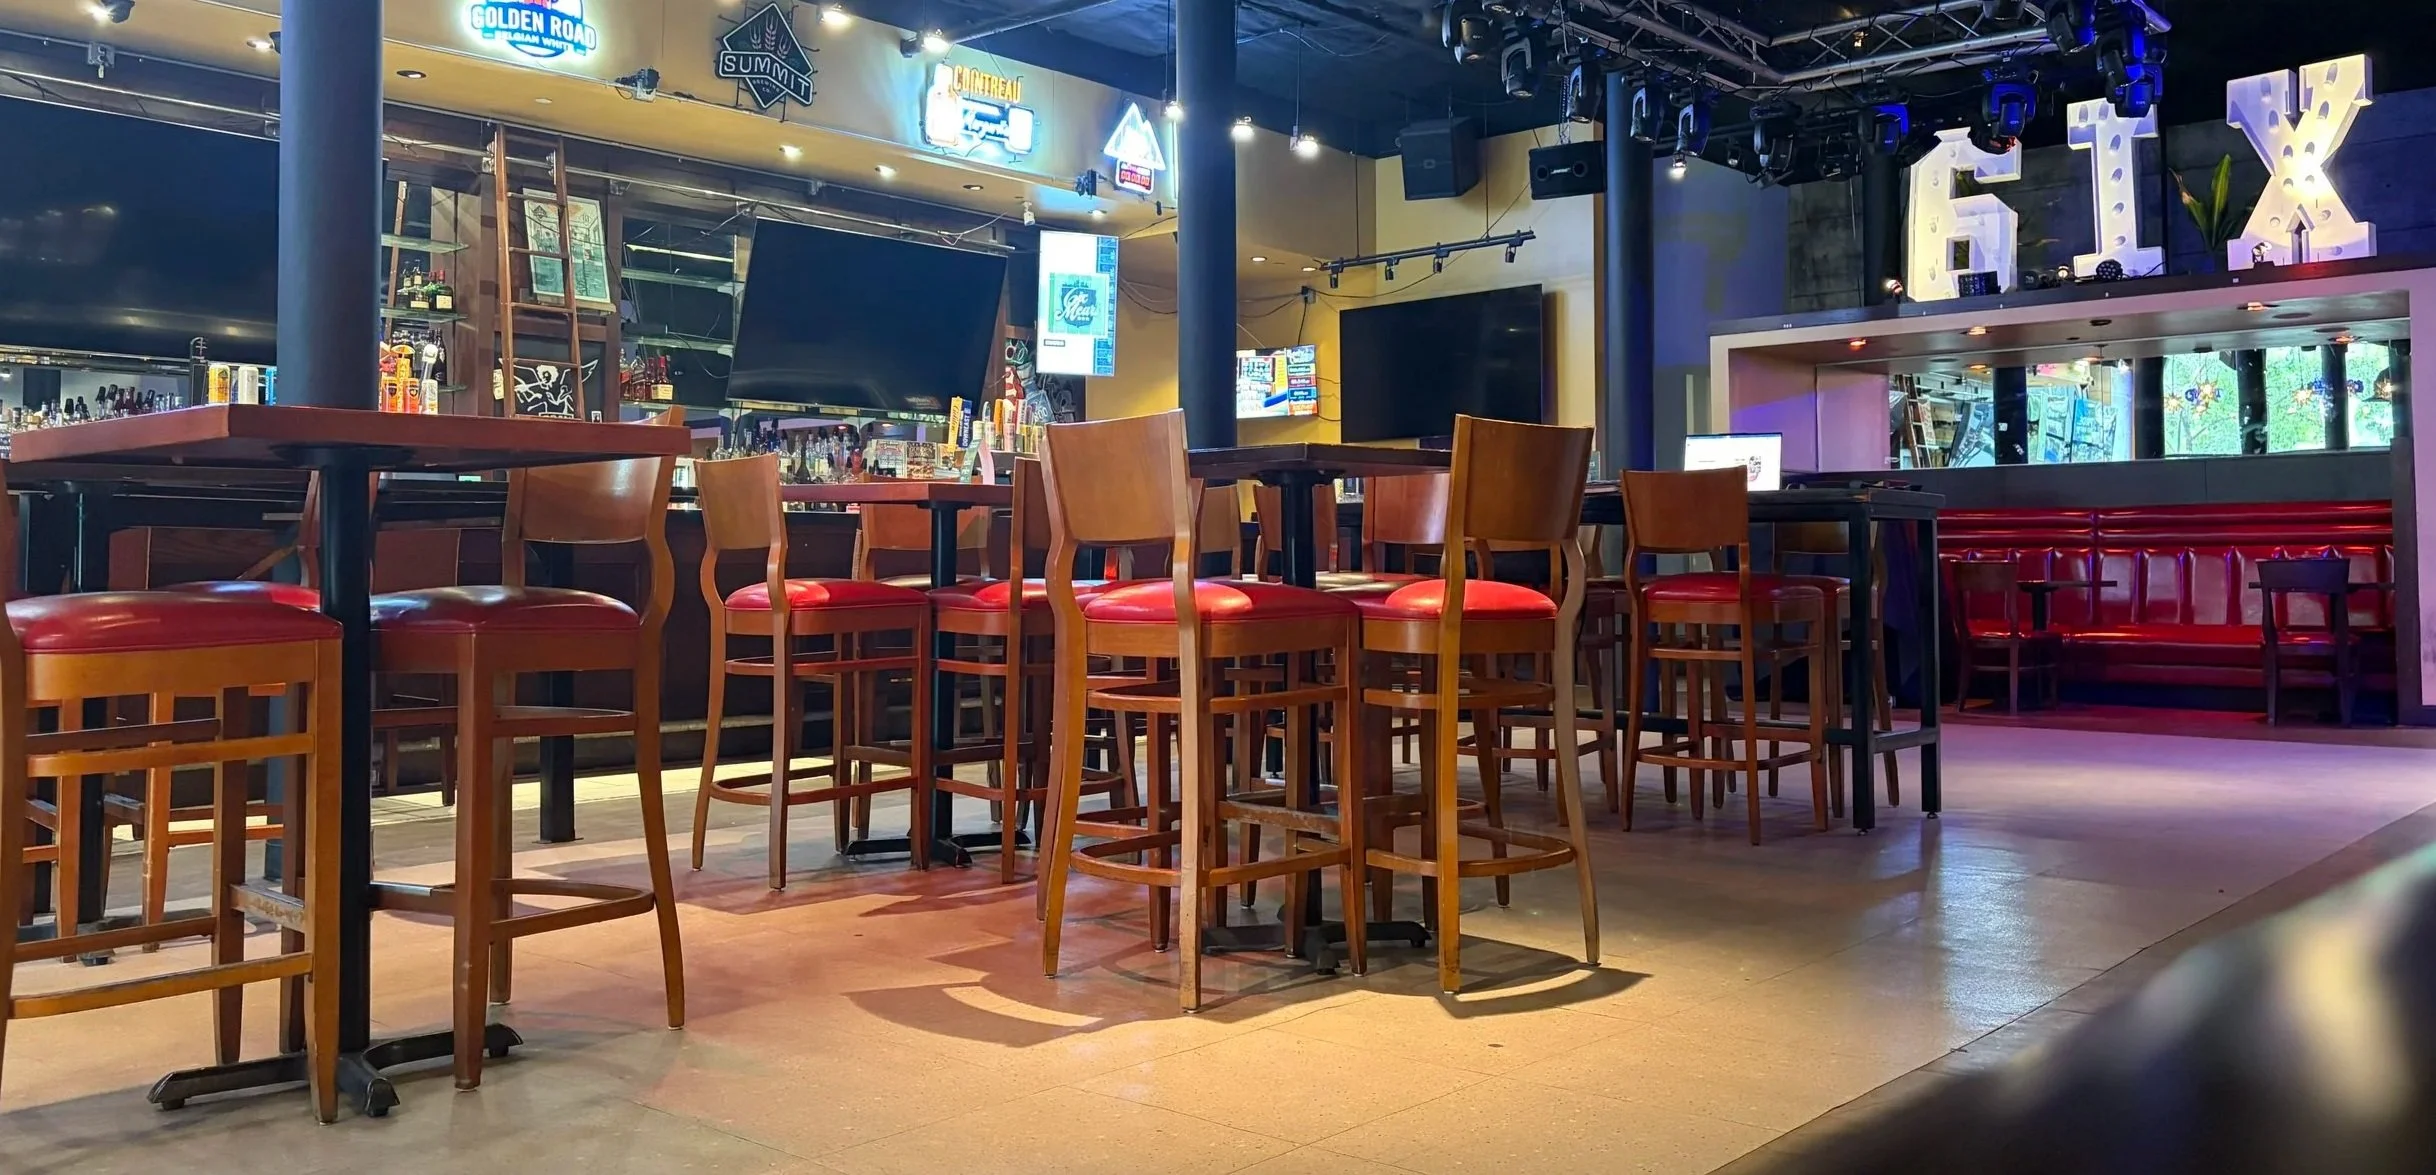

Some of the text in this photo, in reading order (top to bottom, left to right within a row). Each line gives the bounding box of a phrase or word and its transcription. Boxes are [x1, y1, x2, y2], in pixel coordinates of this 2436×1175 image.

[471, 5, 596, 50] GOLDEN ROAD
[724, 55, 810, 96] SUMMIT
[953, 65, 1022, 104] COINTREAU
[962, 413, 972, 447] DOWNEAST
